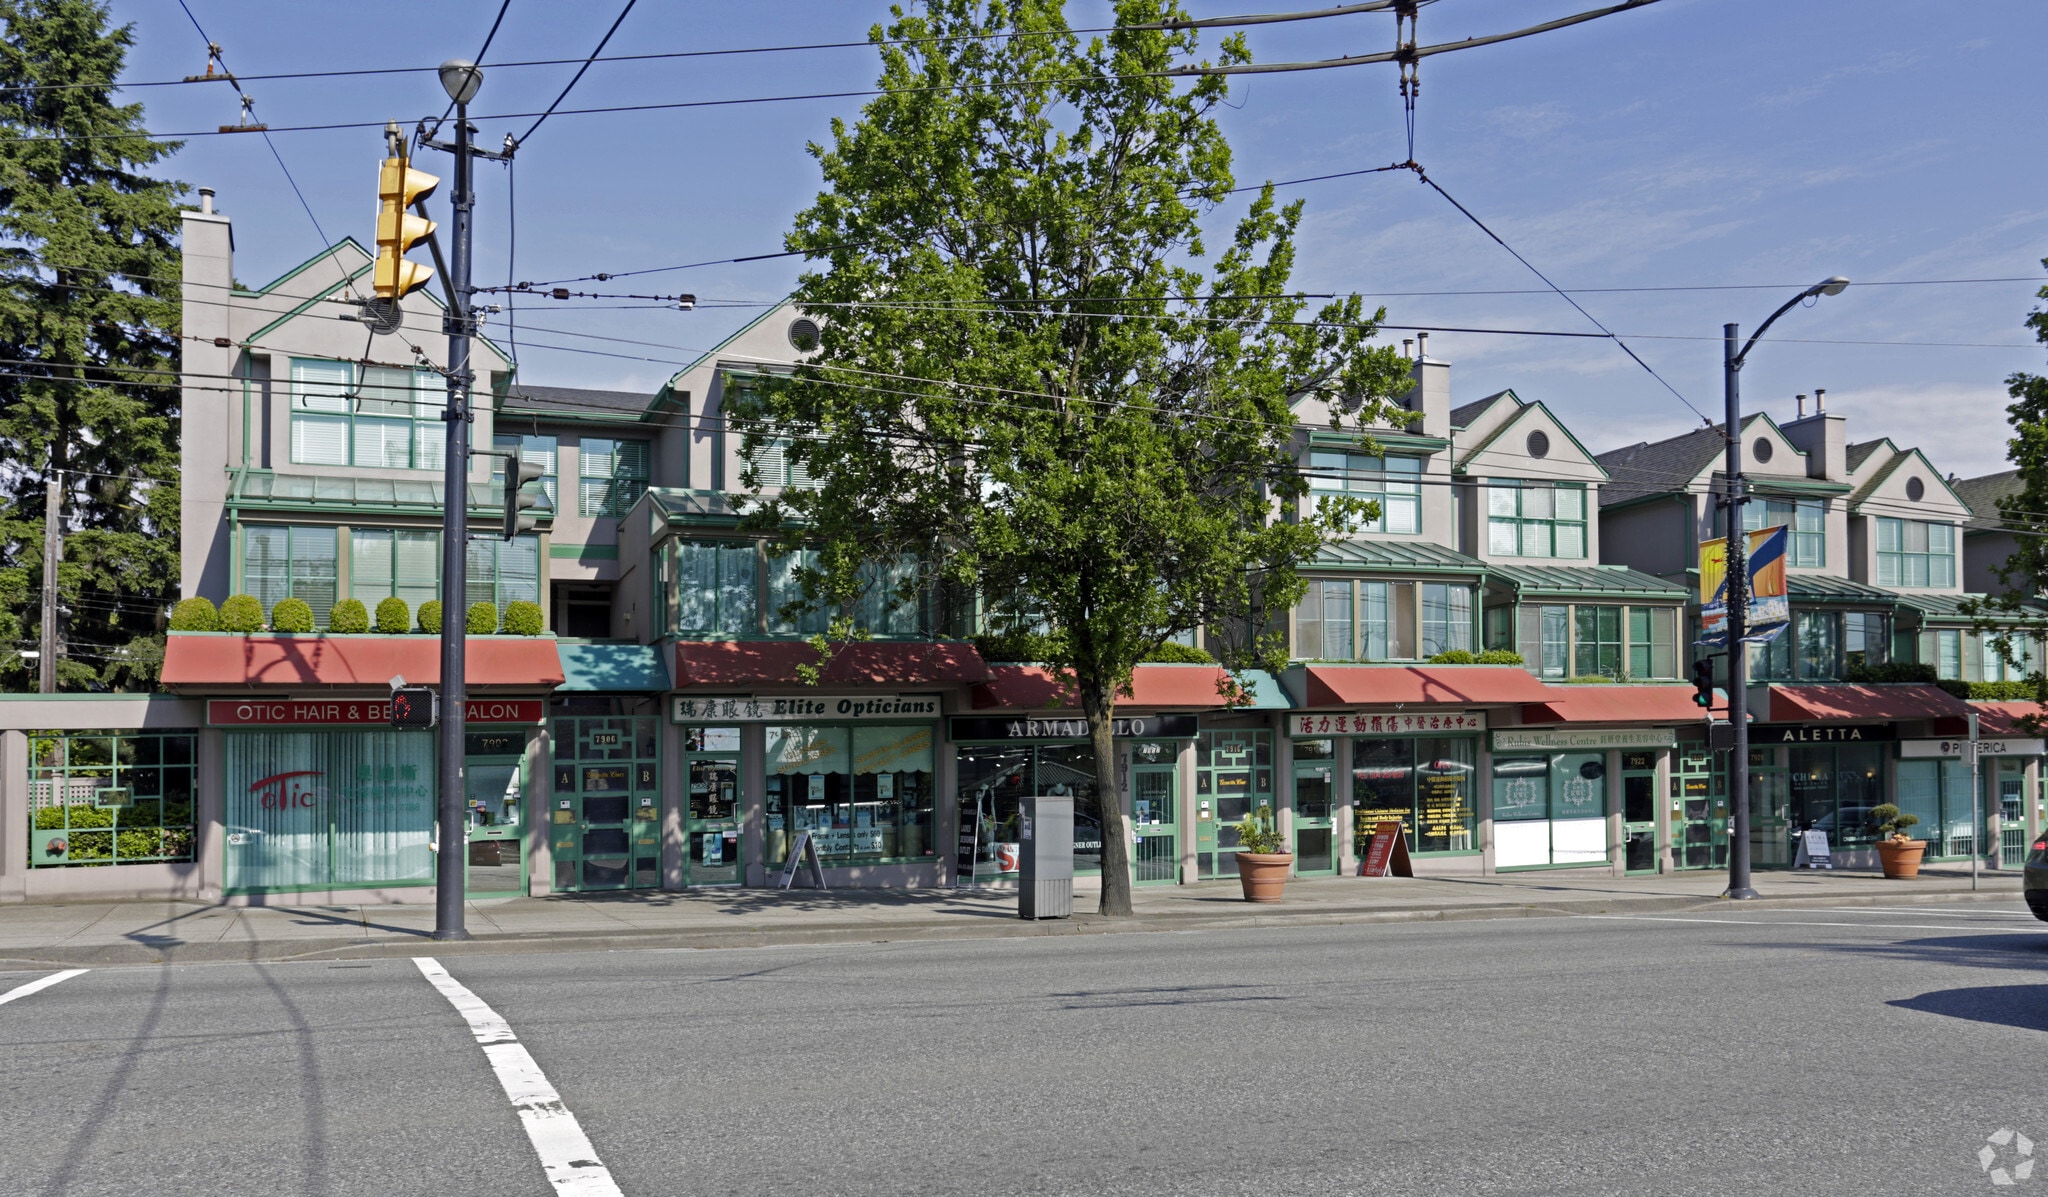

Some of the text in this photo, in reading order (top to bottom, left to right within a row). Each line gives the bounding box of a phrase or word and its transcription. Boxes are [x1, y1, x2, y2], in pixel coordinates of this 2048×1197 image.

[236, 705, 285, 720] OTIC
[294, 705, 340, 720] HAIR
[347, 705, 360, 720] &
[464, 704, 519, 719] ALON
[773, 698, 936, 717] Elite Opticians
[1008, 719, 1145, 737] ARMADLO
[595, 735, 616, 744] 7906
[1507, 734, 1597, 747] Rubis Wellness Centre
[1783, 728, 1862, 742] ALETTA
[1952, 742, 2007, 754] PERICA
[1630, 757, 1645, 765] 7922
[561, 772, 569, 784] A
[642, 770, 650, 782] B
[1260, 777, 1267, 787] B
[1201, 778, 1208, 788] A
[811, 832, 830, 840] Frame
[857, 831, 869, 841] only
[813, 843, 833, 853] onthly
[871, 841, 882, 850] $10
